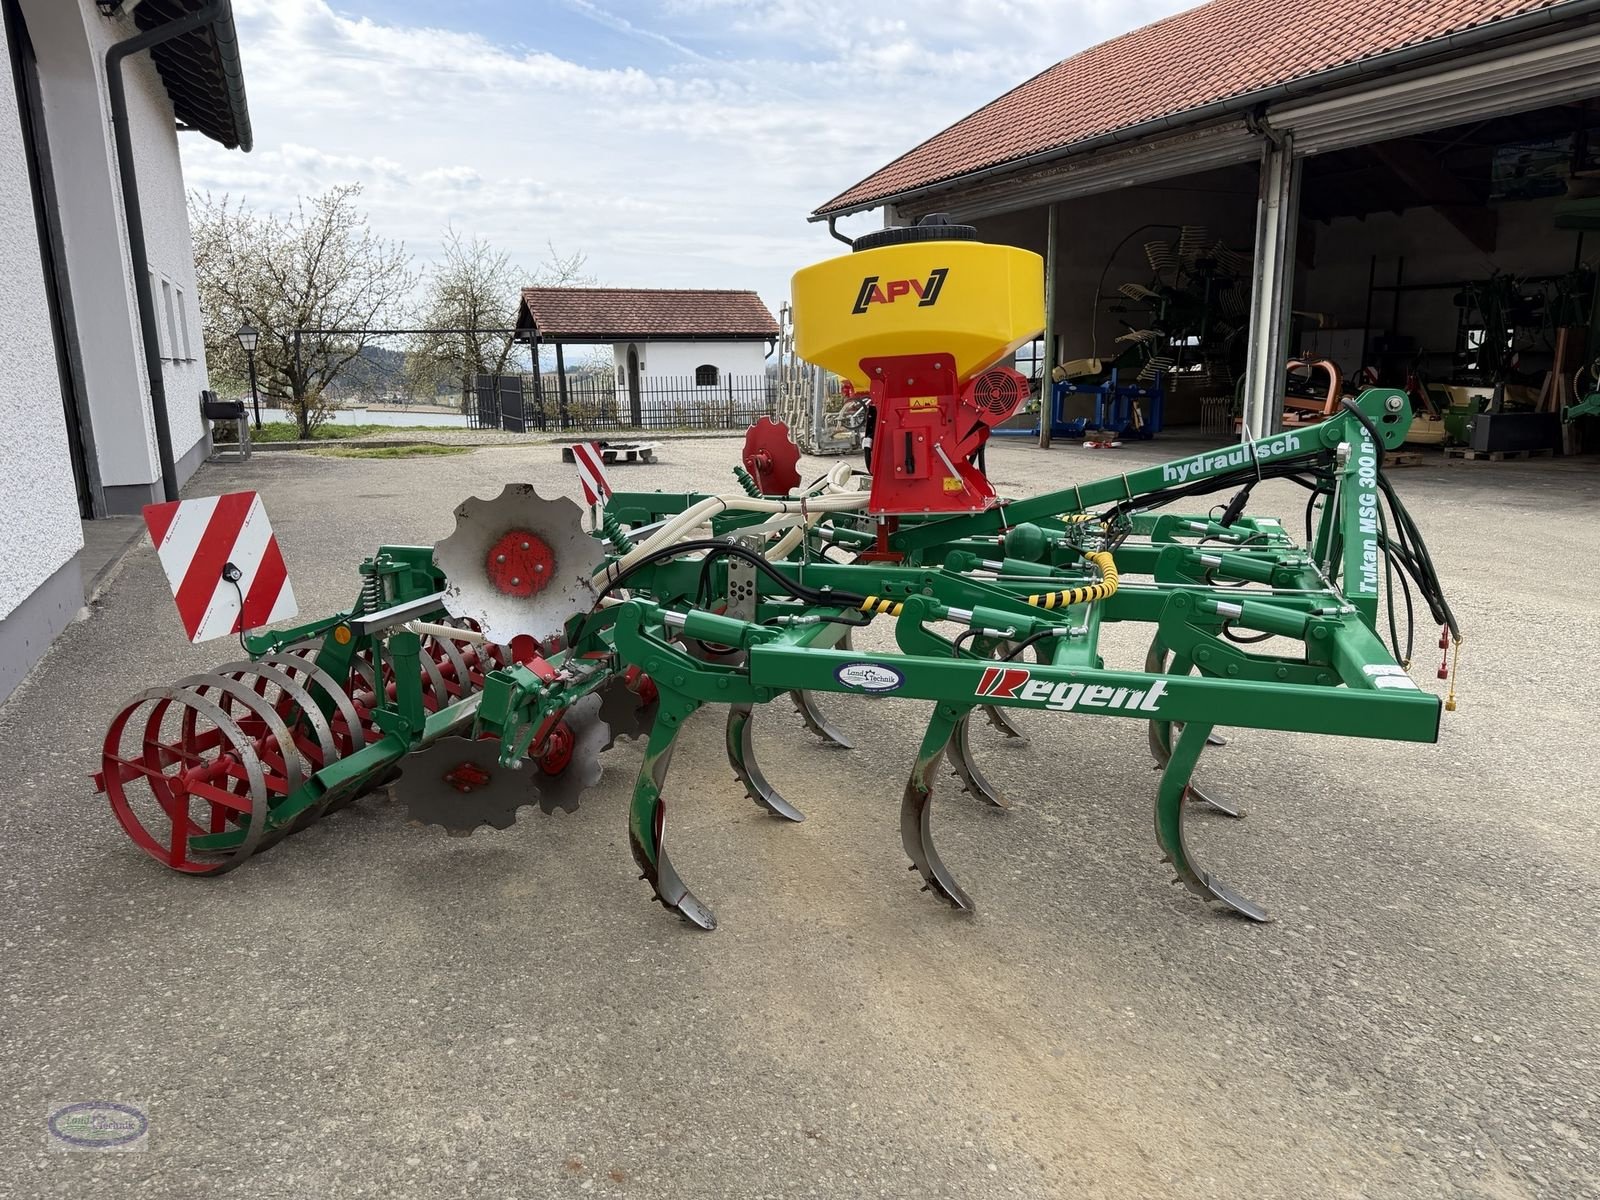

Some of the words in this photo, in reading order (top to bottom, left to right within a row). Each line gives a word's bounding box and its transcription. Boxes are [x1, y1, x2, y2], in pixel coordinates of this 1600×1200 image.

[861, 275, 940, 306] APV
[1358, 456, 1376, 488] 300
[1358, 493, 1377, 534] MSG
[1360, 539, 1377, 593] Tukan
[847, 669, 864, 677] Land
[869, 674, 895, 683] Technik
[974, 666, 1169, 711] Regent
